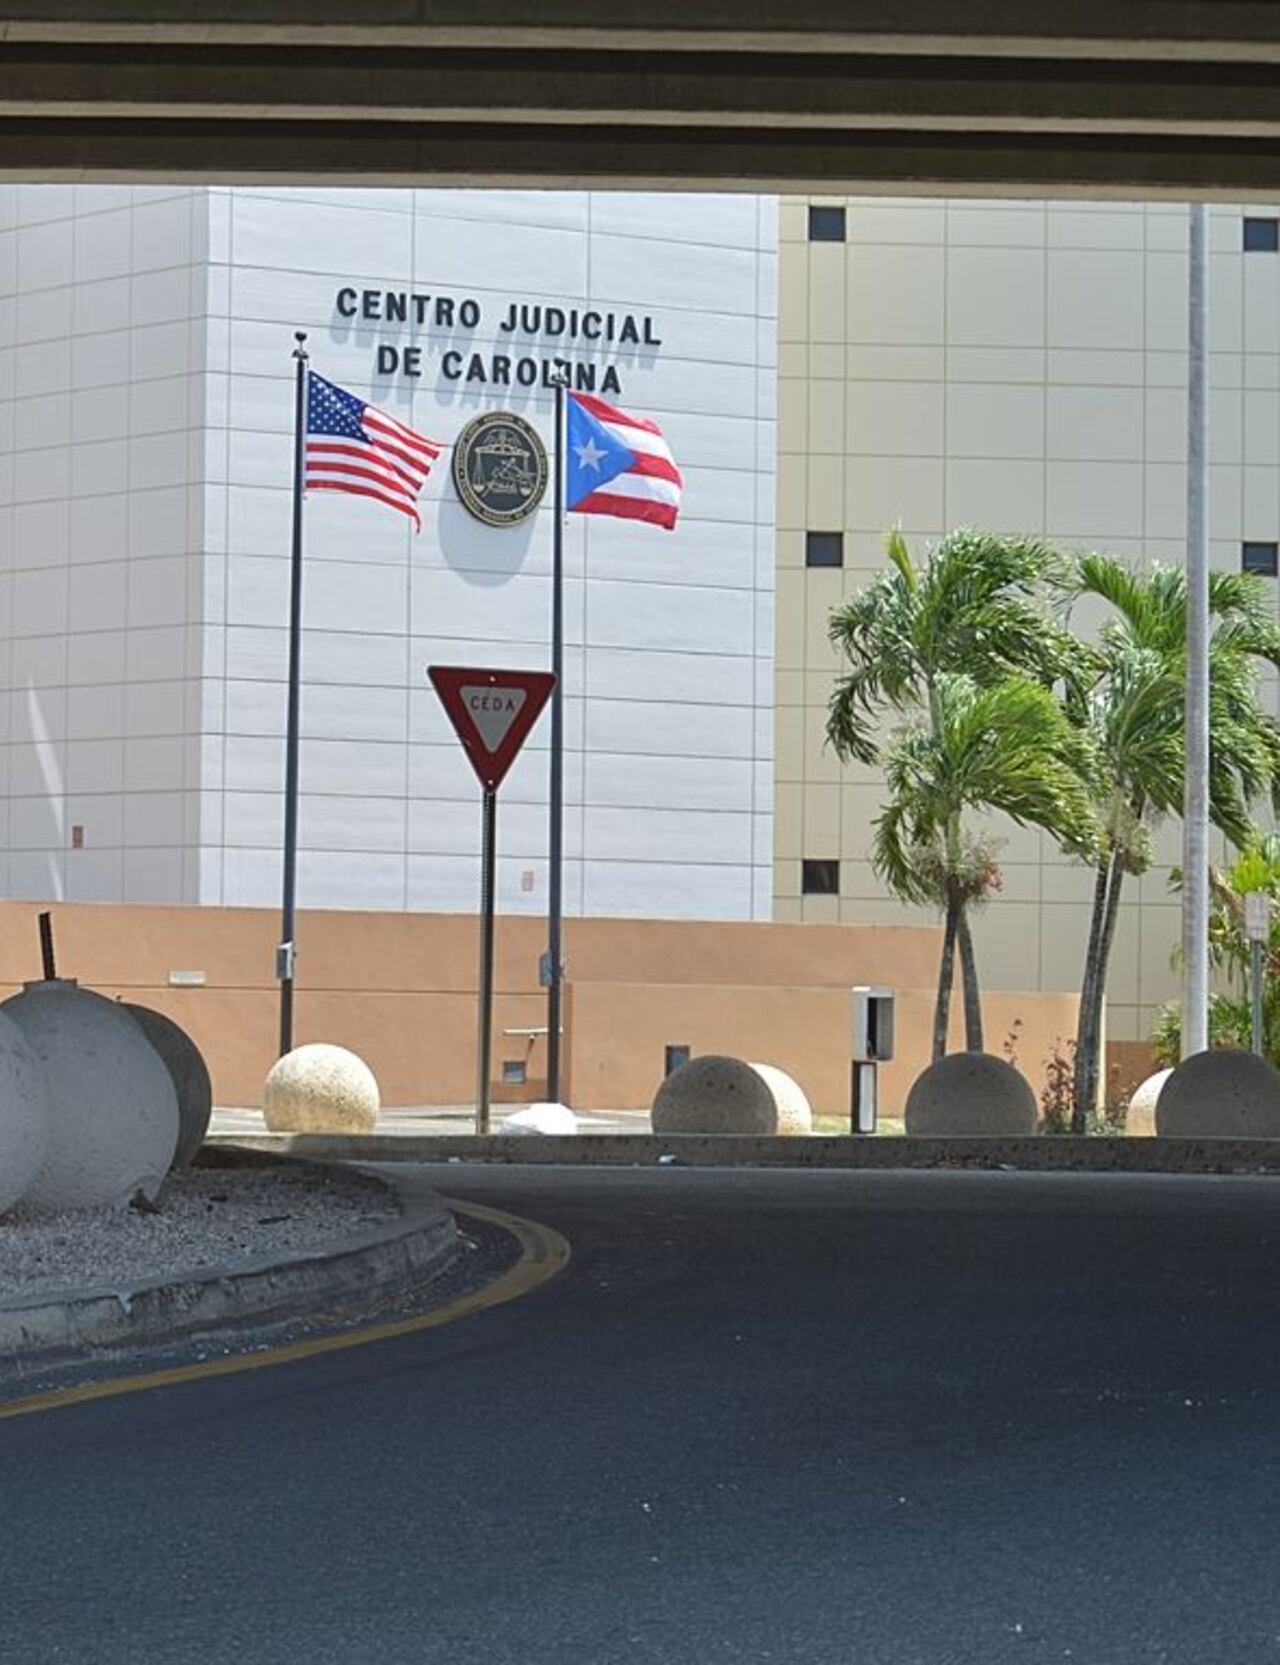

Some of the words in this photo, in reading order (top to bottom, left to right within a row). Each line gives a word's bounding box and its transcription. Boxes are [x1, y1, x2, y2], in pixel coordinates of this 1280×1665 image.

[336, 287, 481, 329] CENTRO
[500, 303, 663, 346] JUDICIAL
[377, 345, 423, 377] DE
[441, 350, 621, 394] CAROLINA
[470, 695, 516, 712] CEDA
